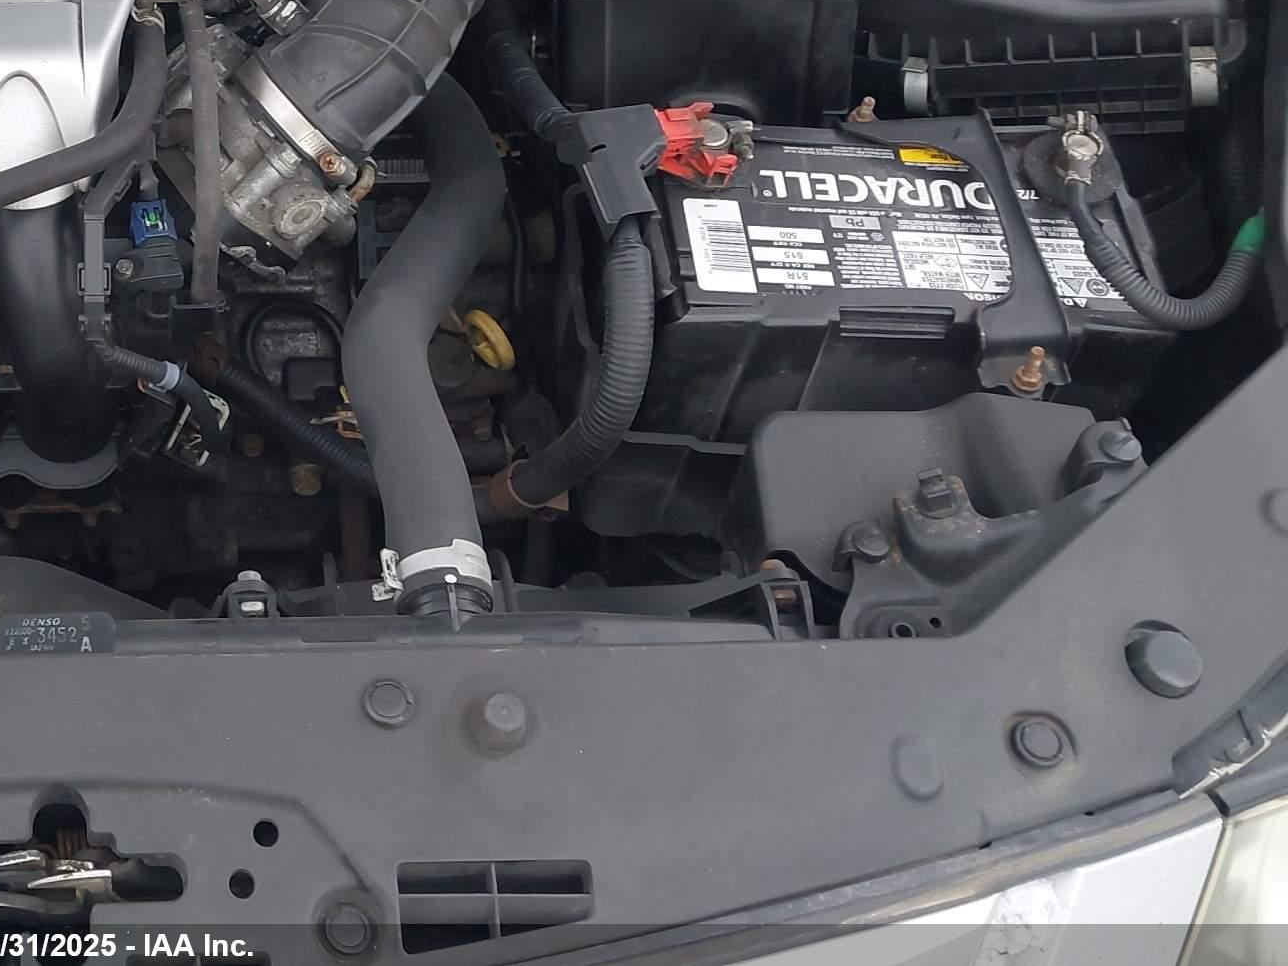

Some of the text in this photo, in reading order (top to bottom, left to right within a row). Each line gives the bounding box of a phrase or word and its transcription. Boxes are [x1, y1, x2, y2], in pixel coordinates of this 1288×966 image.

[759, 170, 996, 210] DURACELL
[846, 218, 865, 227] Pb
[778, 231, 798, 240] 500
[785, 271, 809, 281] 51R
[21, 617, 61, 627] DENSO
[80, 635, 92, 653] A
